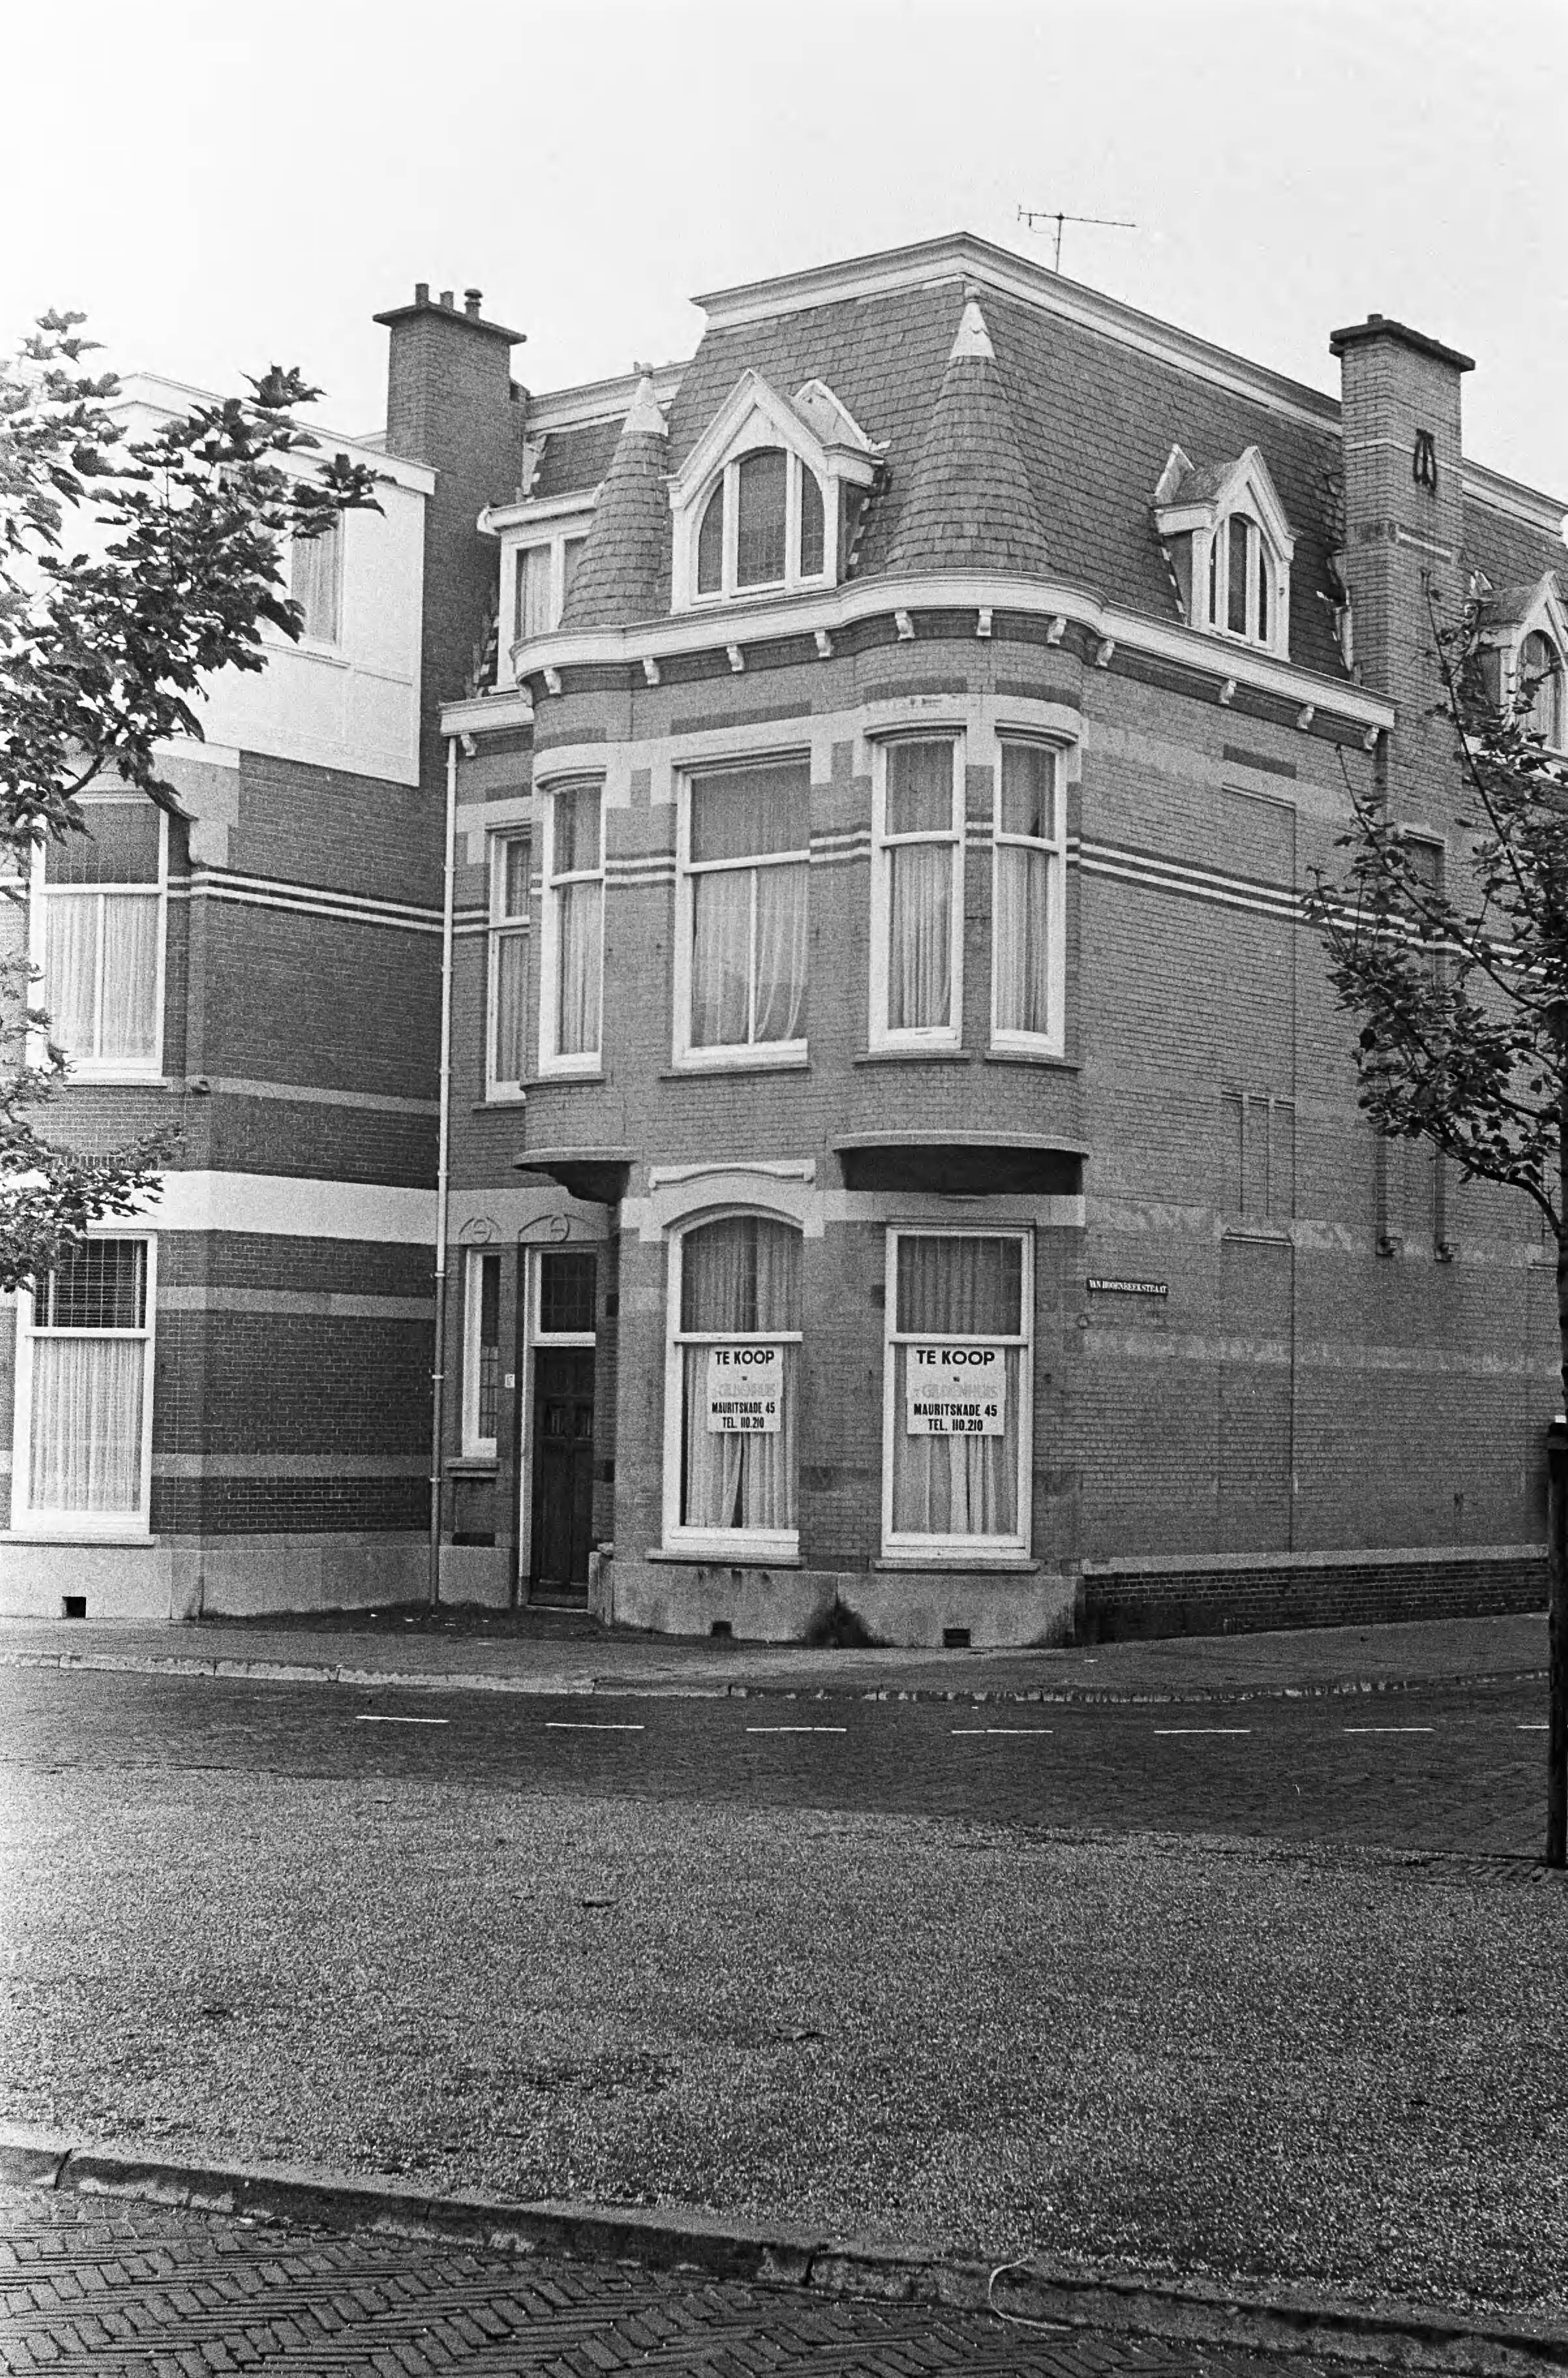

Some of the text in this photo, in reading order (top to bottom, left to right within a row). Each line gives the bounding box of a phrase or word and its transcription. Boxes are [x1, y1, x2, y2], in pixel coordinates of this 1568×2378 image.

[715, 1350, 775, 1365] TE KOOP
[916, 1350, 995, 1365] TE KOOP
[712, 1402, 775, 1414] MAURITSKADE 45
[914, 1403, 998, 1417] MAURITSKADE 45
[722, 1417, 738, 1429] TEL.
[928, 1418, 983, 1431] TEL. 110.210
